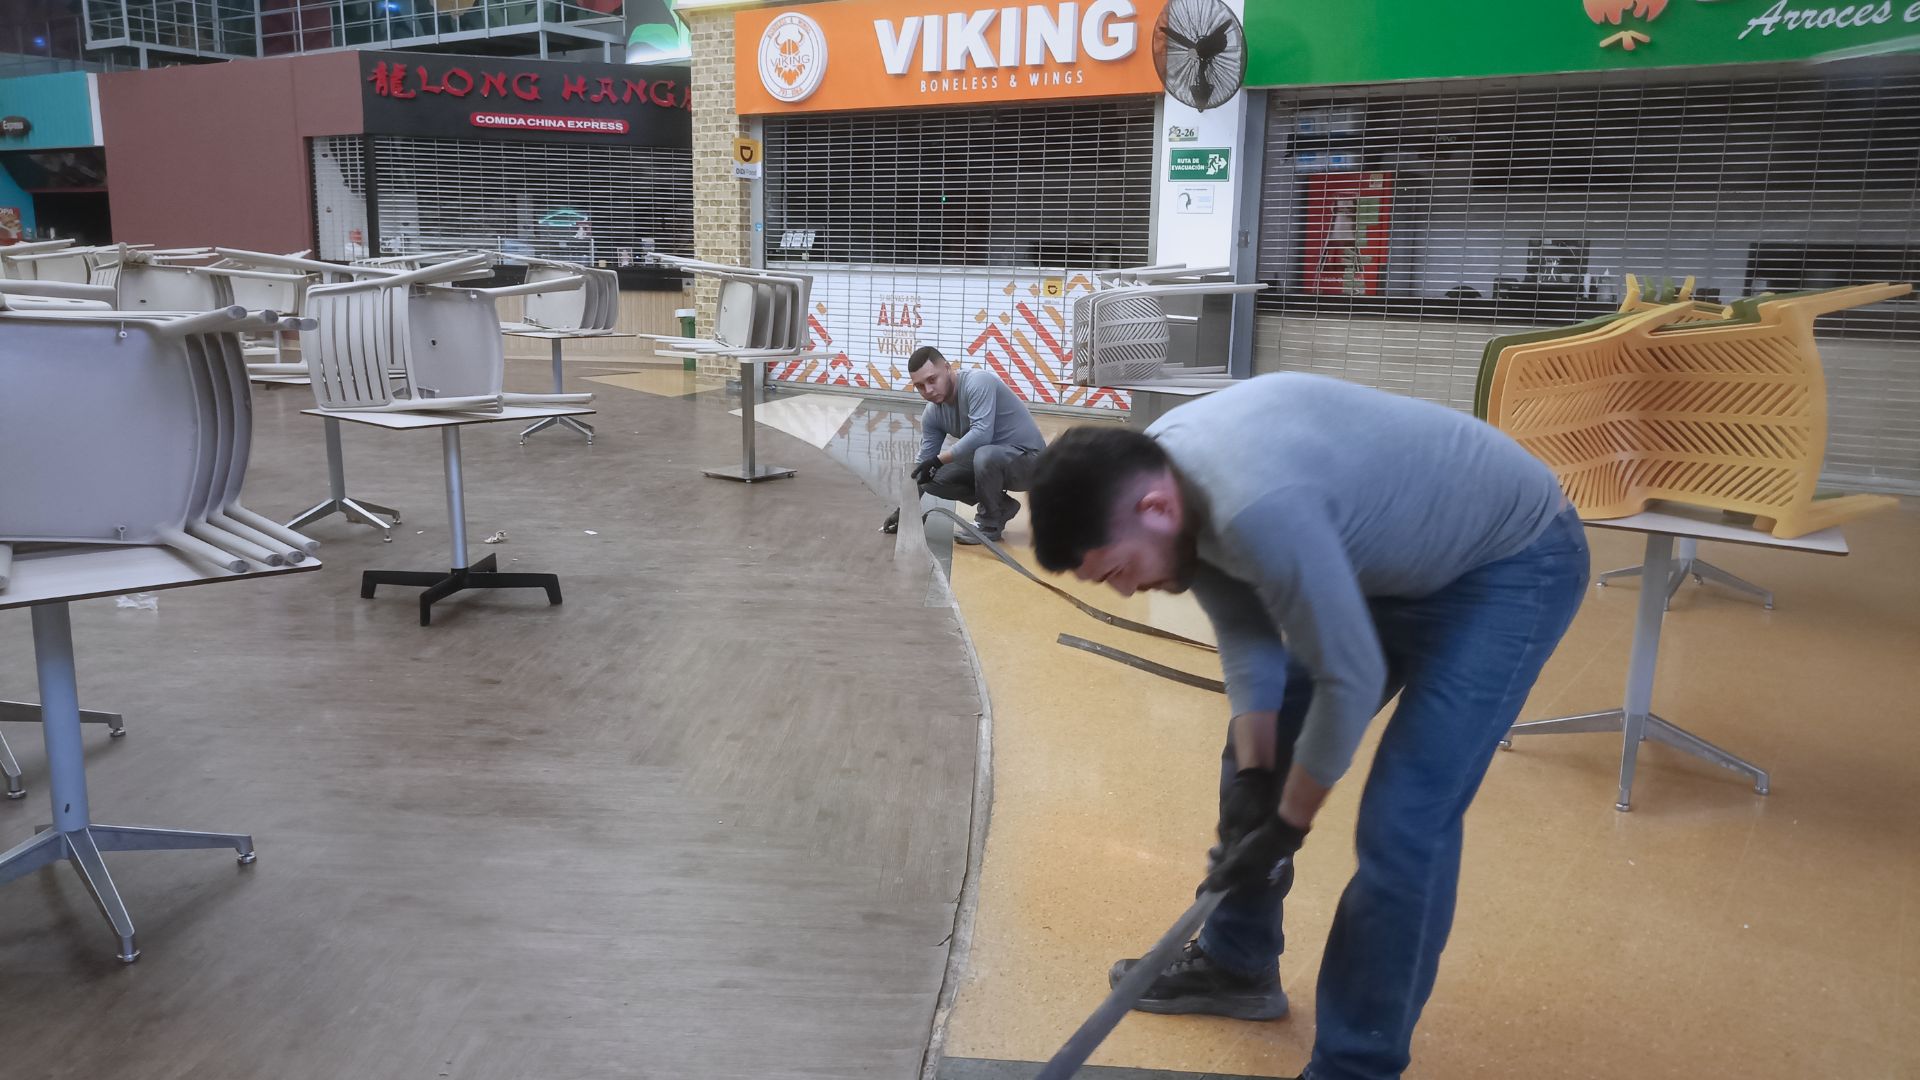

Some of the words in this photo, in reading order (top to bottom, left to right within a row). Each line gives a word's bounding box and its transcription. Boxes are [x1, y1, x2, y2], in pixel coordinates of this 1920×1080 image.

[1737, 0, 1893, 40] Arroces
[873, 0, 1139, 75] VIKING
[770, 54, 810, 68] VIKING
[417, 65, 542, 102] LONG
[920, 75, 998, 93] BONELESS
[1009, 74, 1018, 88] &
[1028, 70, 1085, 87] WINGS
[475, 114, 526, 127] COMIDA
[527, 117, 565, 129] CHINA
[566, 119, 624, 132] EXPRESS
[1176, 128, 1195, 137] 2-26
[877, 302, 923, 328] ALAS
